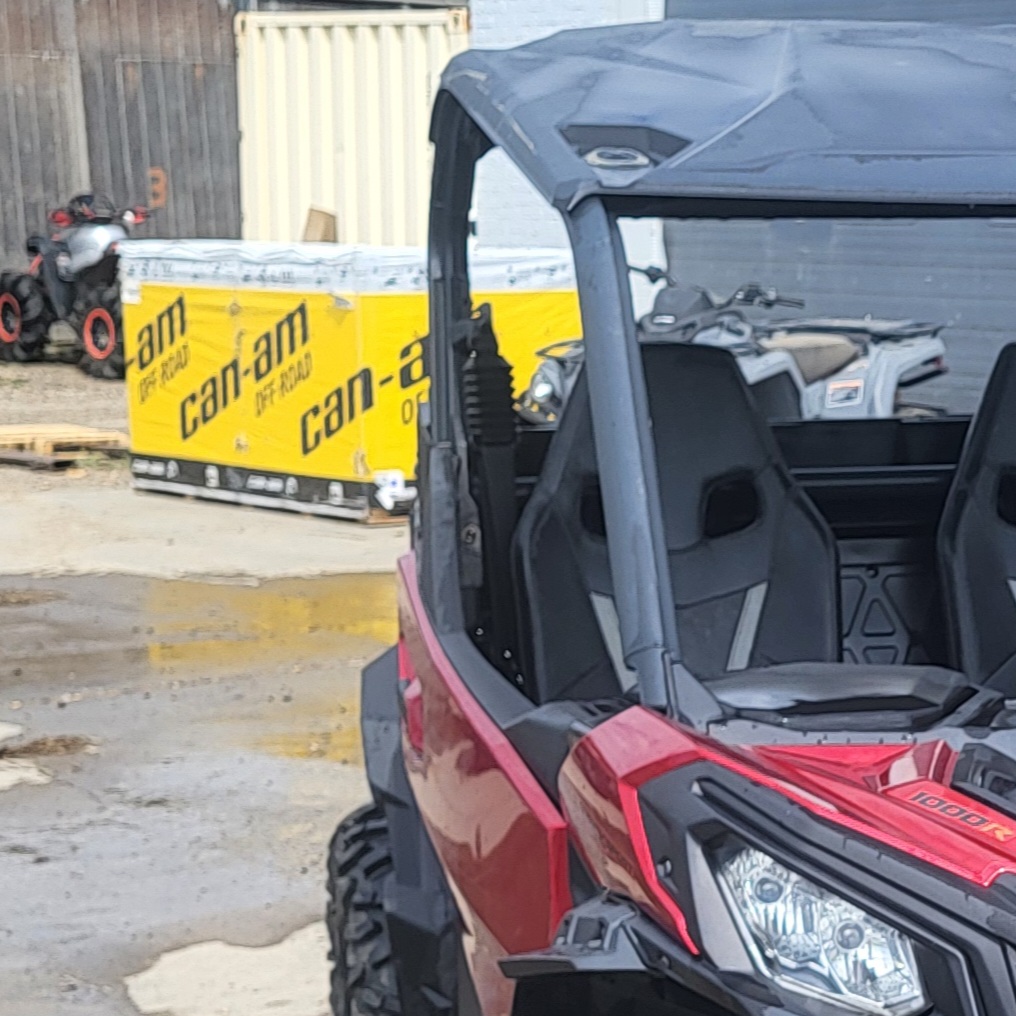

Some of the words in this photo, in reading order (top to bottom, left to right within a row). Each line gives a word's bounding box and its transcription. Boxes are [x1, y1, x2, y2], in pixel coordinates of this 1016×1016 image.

[180, 302, 309, 440] can-am
[300, 335, 431, 456] can-a
[911, 791, 1014, 842] 1000R
